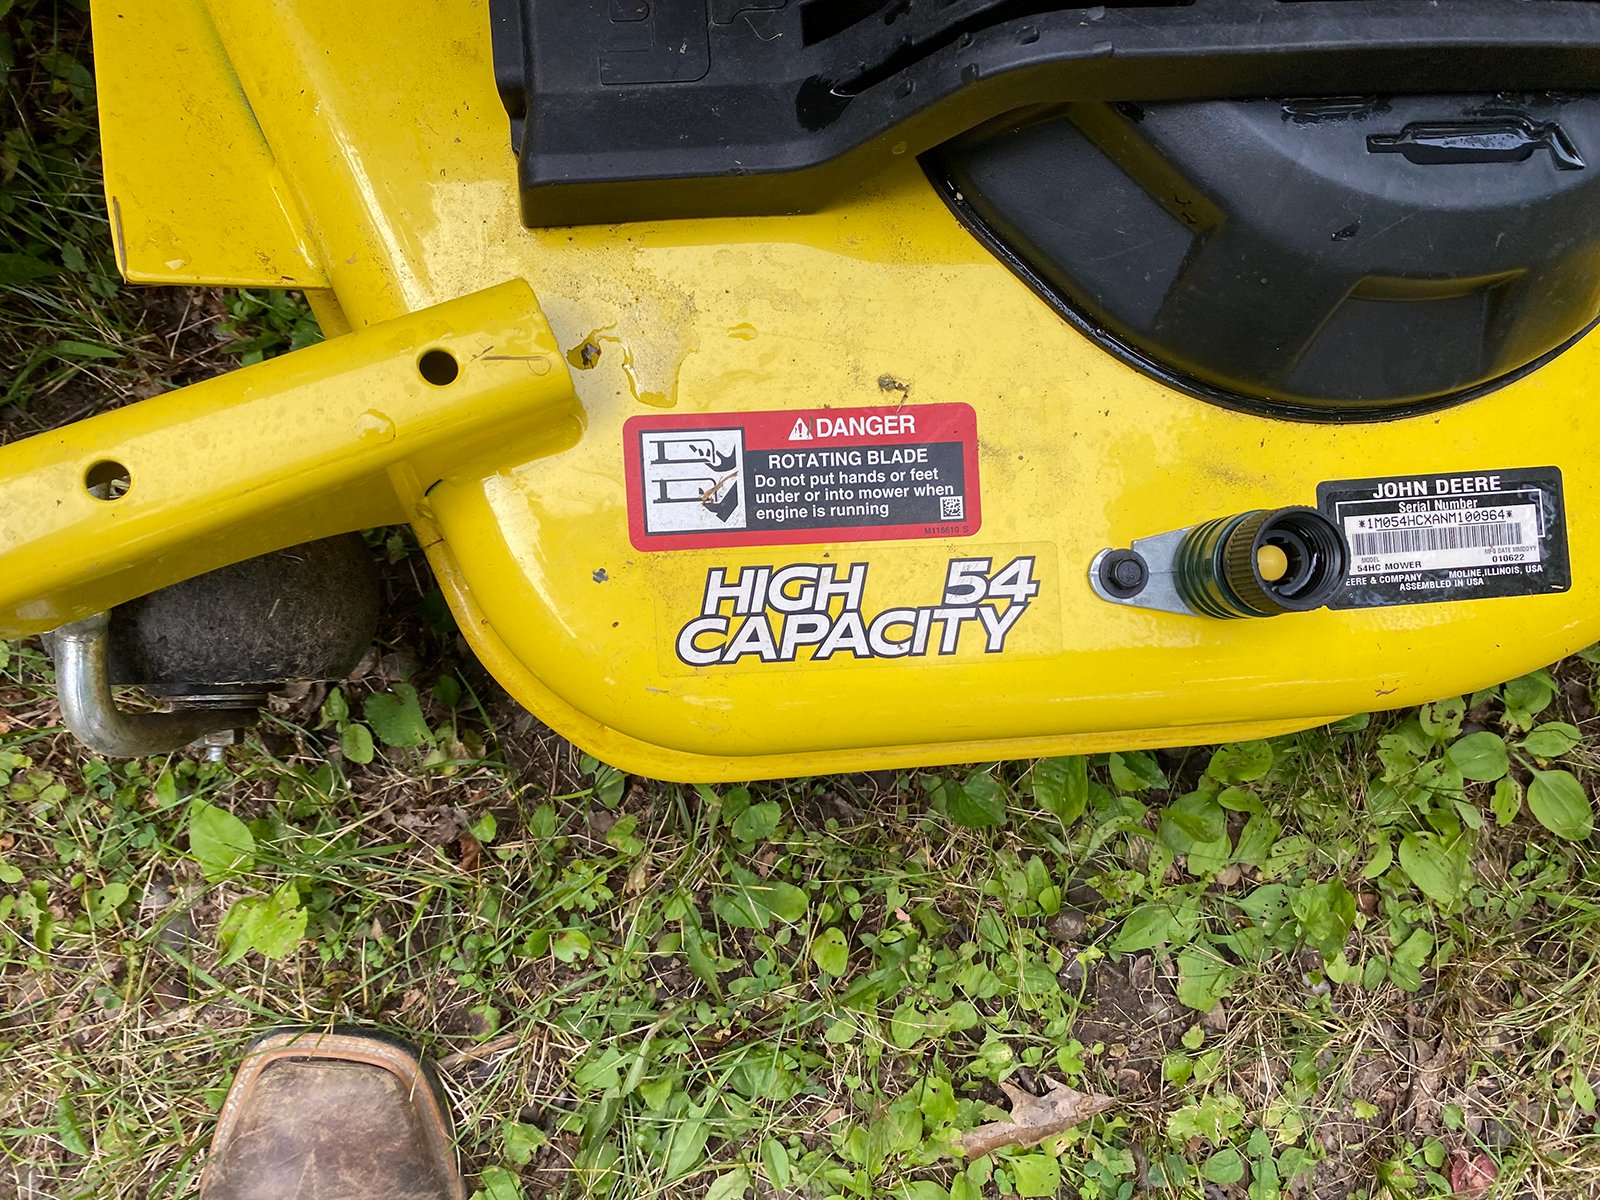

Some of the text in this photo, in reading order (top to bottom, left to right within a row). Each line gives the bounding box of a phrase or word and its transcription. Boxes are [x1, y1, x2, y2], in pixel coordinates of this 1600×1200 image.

[817, 415, 915, 437] DANGER
[769, 449, 928, 469] ROTATING BLADE
[755, 468, 938, 488] Do not put hands or feet
[1373, 476, 1501, 499] JOHN DEERE
[756, 485, 953, 504] under or into mower when
[756, 503, 889, 522] engine is running
[1399, 498, 1478, 513] Serial Number
[1358, 561, 1421, 572] 54HC MOWER
[1492, 554, 1525, 562] 010622
[1526, 565, 1543, 573] USA
[703, 556, 1041, 617] HIGH 54
[1346, 577, 1367, 586] EERE
[1380, 573, 1422, 583] COMPANY
[1400, 580, 1451, 591] ASSEMBLED
[1466, 578, 1484, 586] USA
[675, 602, 1031, 666] CAPACITY
